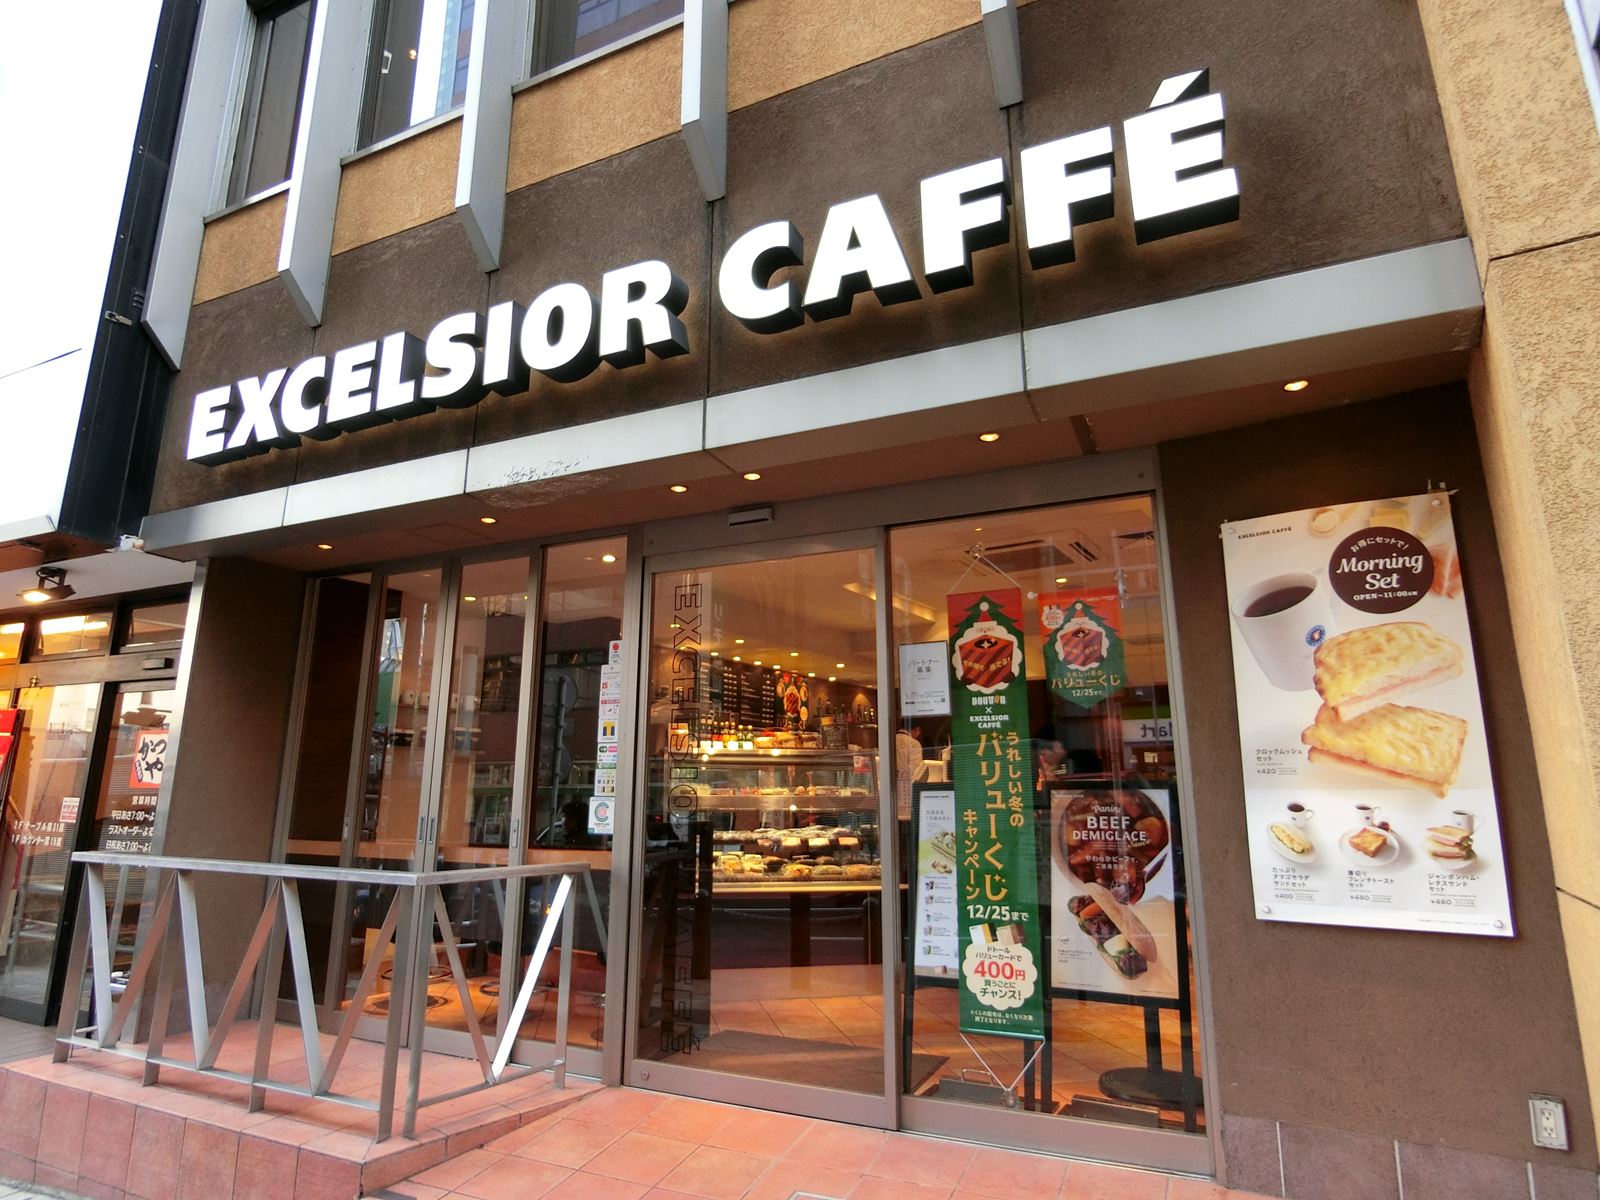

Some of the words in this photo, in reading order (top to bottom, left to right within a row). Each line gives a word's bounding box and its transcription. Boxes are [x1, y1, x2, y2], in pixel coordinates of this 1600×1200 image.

[186, 260, 687, 463] EXCELSIOR
[719, 69, 1240, 332] CAFFÉ
[1336, 553, 1424, 574] Morning
[1364, 573, 1400, 590] Set
[667, 583, 702, 850] EXCELSIO
[976, 731, 1008, 901] バリューくじ
[1091, 803, 1122, 814] Panini
[1086, 816, 1130, 829] BEEF
[1072, 830, 1147, 841] DEMIGLACE
[963, 809, 980, 900] キャンペーン
[967, 904, 1030, 921] 12/25まで
[974, 960, 1026, 980] 400円
